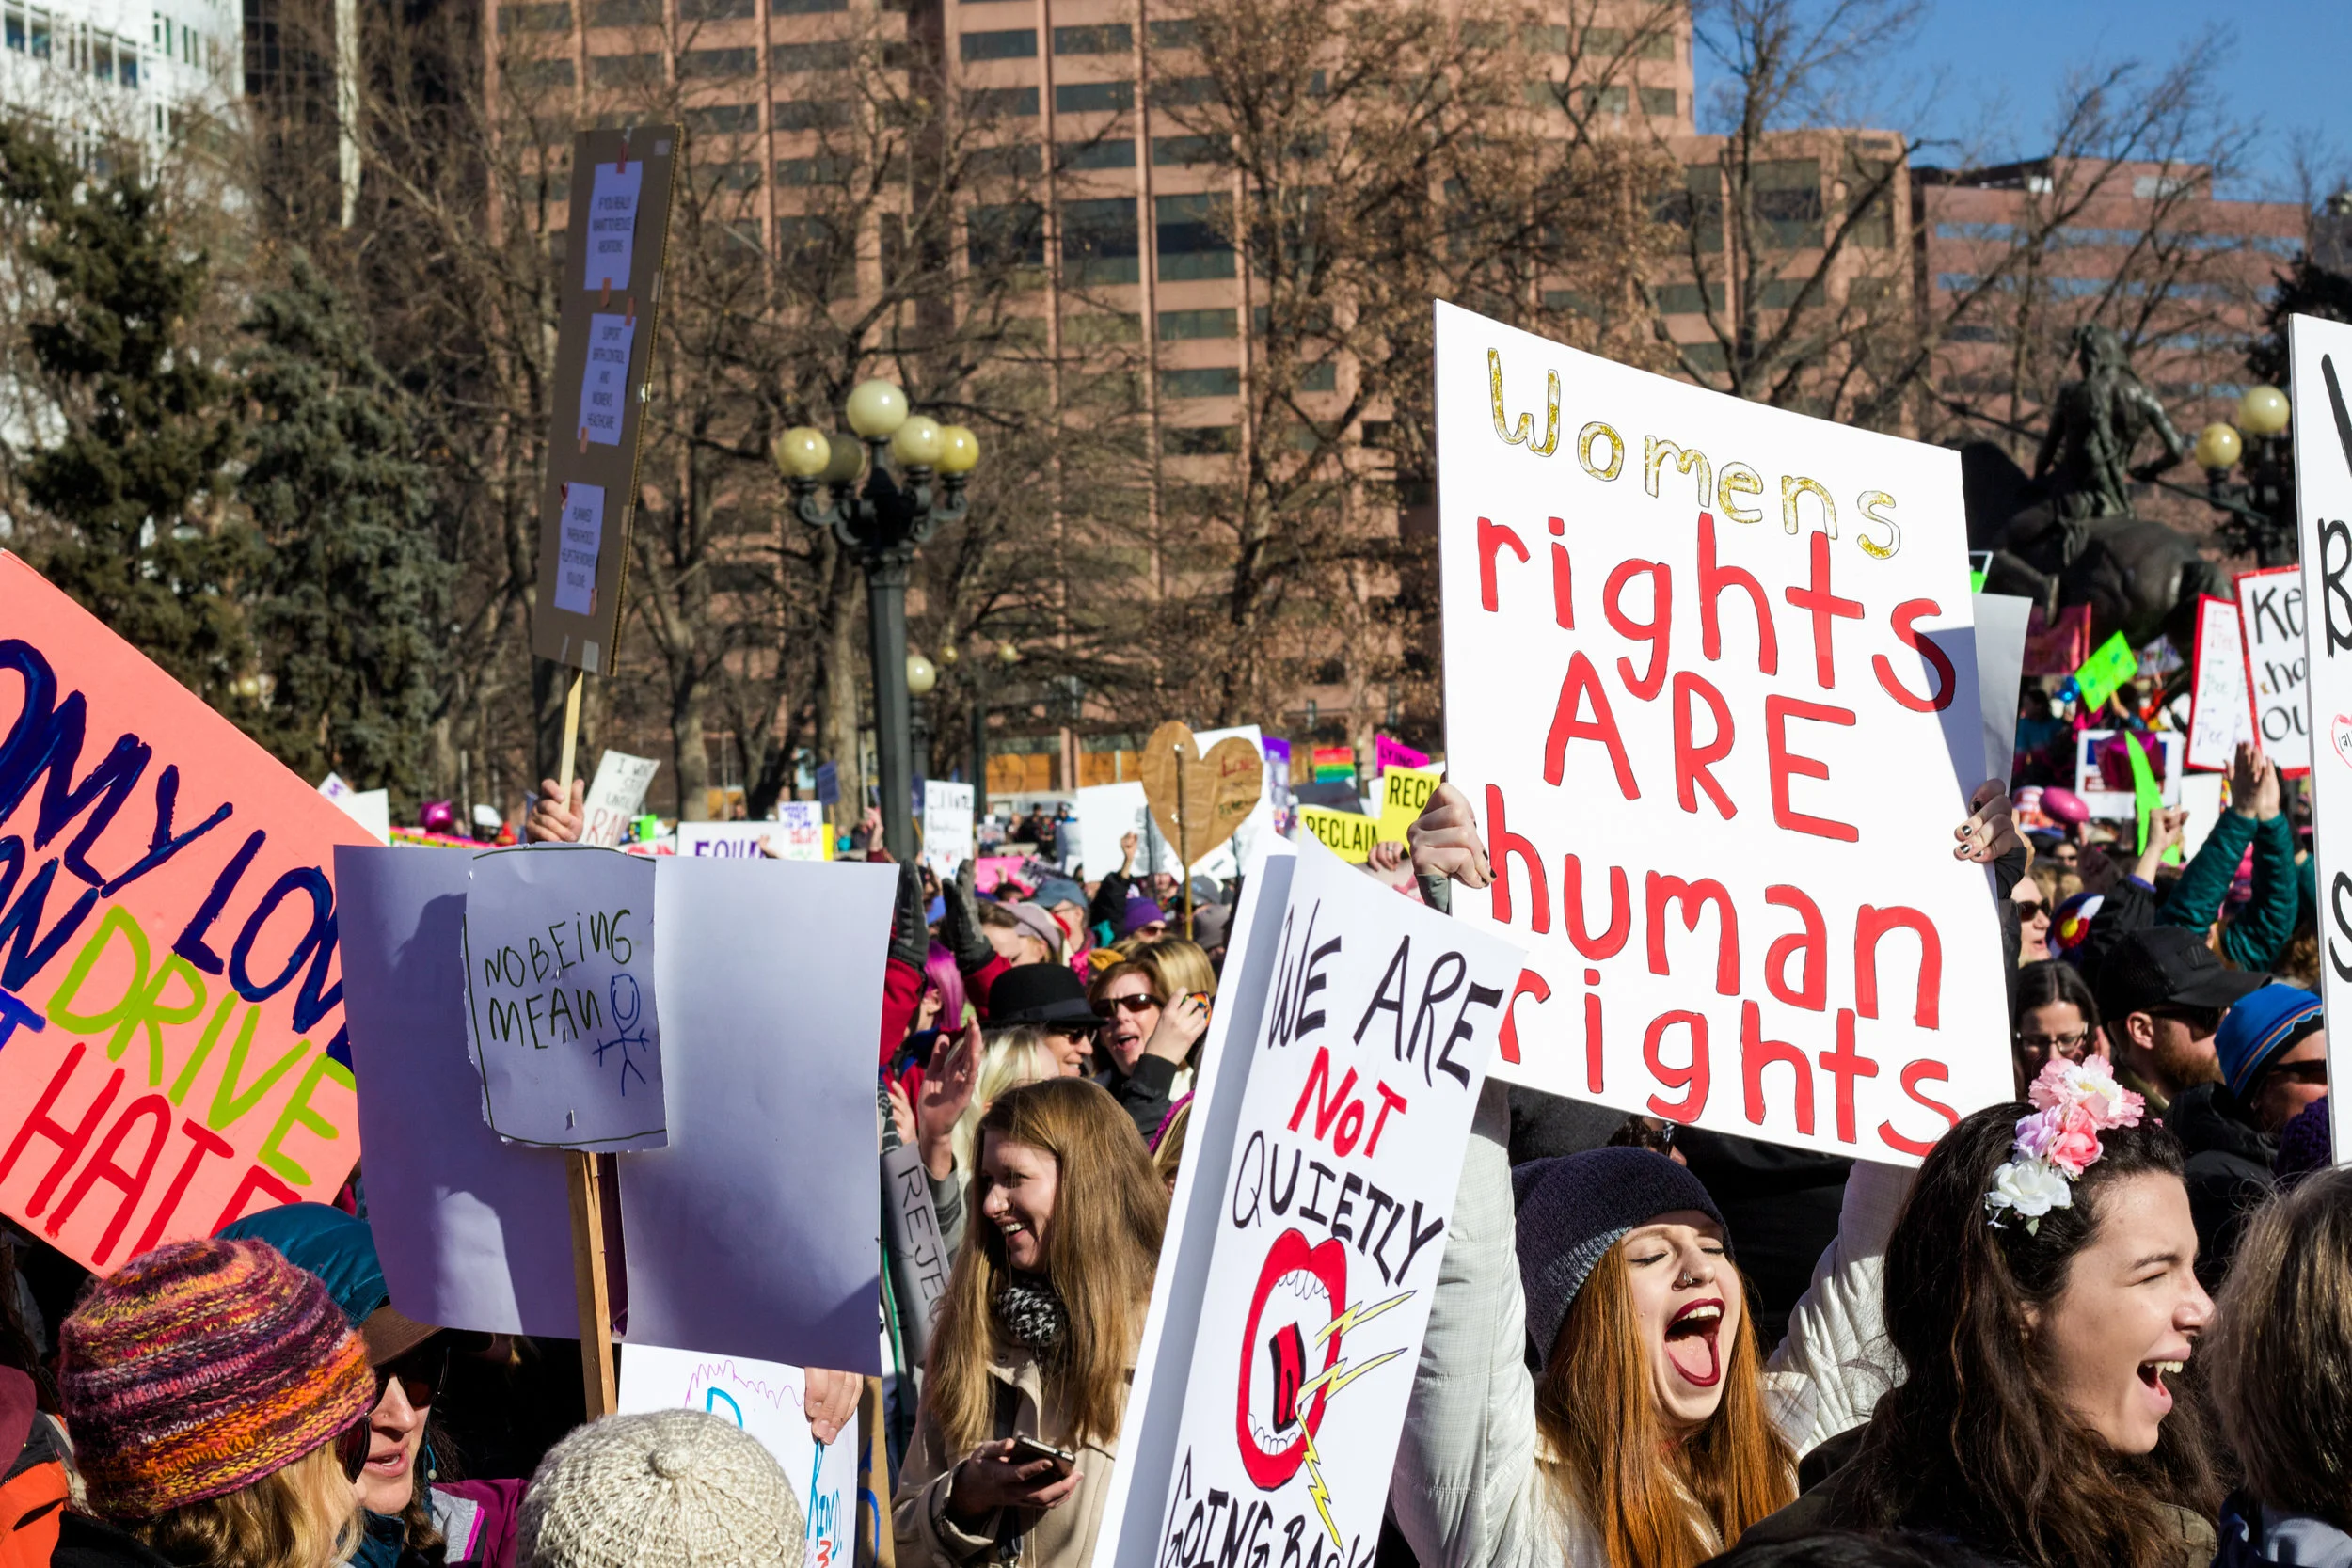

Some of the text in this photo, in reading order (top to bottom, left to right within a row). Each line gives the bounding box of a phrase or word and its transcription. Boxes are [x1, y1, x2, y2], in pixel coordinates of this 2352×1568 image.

[1487, 347, 1901, 560] Womens
[1477, 511, 1957, 713] rights
[1543, 650, 1860, 844] ARE
[171, 829, 352, 1073] LOV
[1268, 898, 1504, 1091] WE ARE
[1485, 783, 1943, 1031] human
[45, 904, 357, 1187] DRIVE
[489, 987, 603, 1050] MEAN
[1498, 967, 1963, 1158] rights
[1232, 1129, 1444, 1287] QUIETLY
